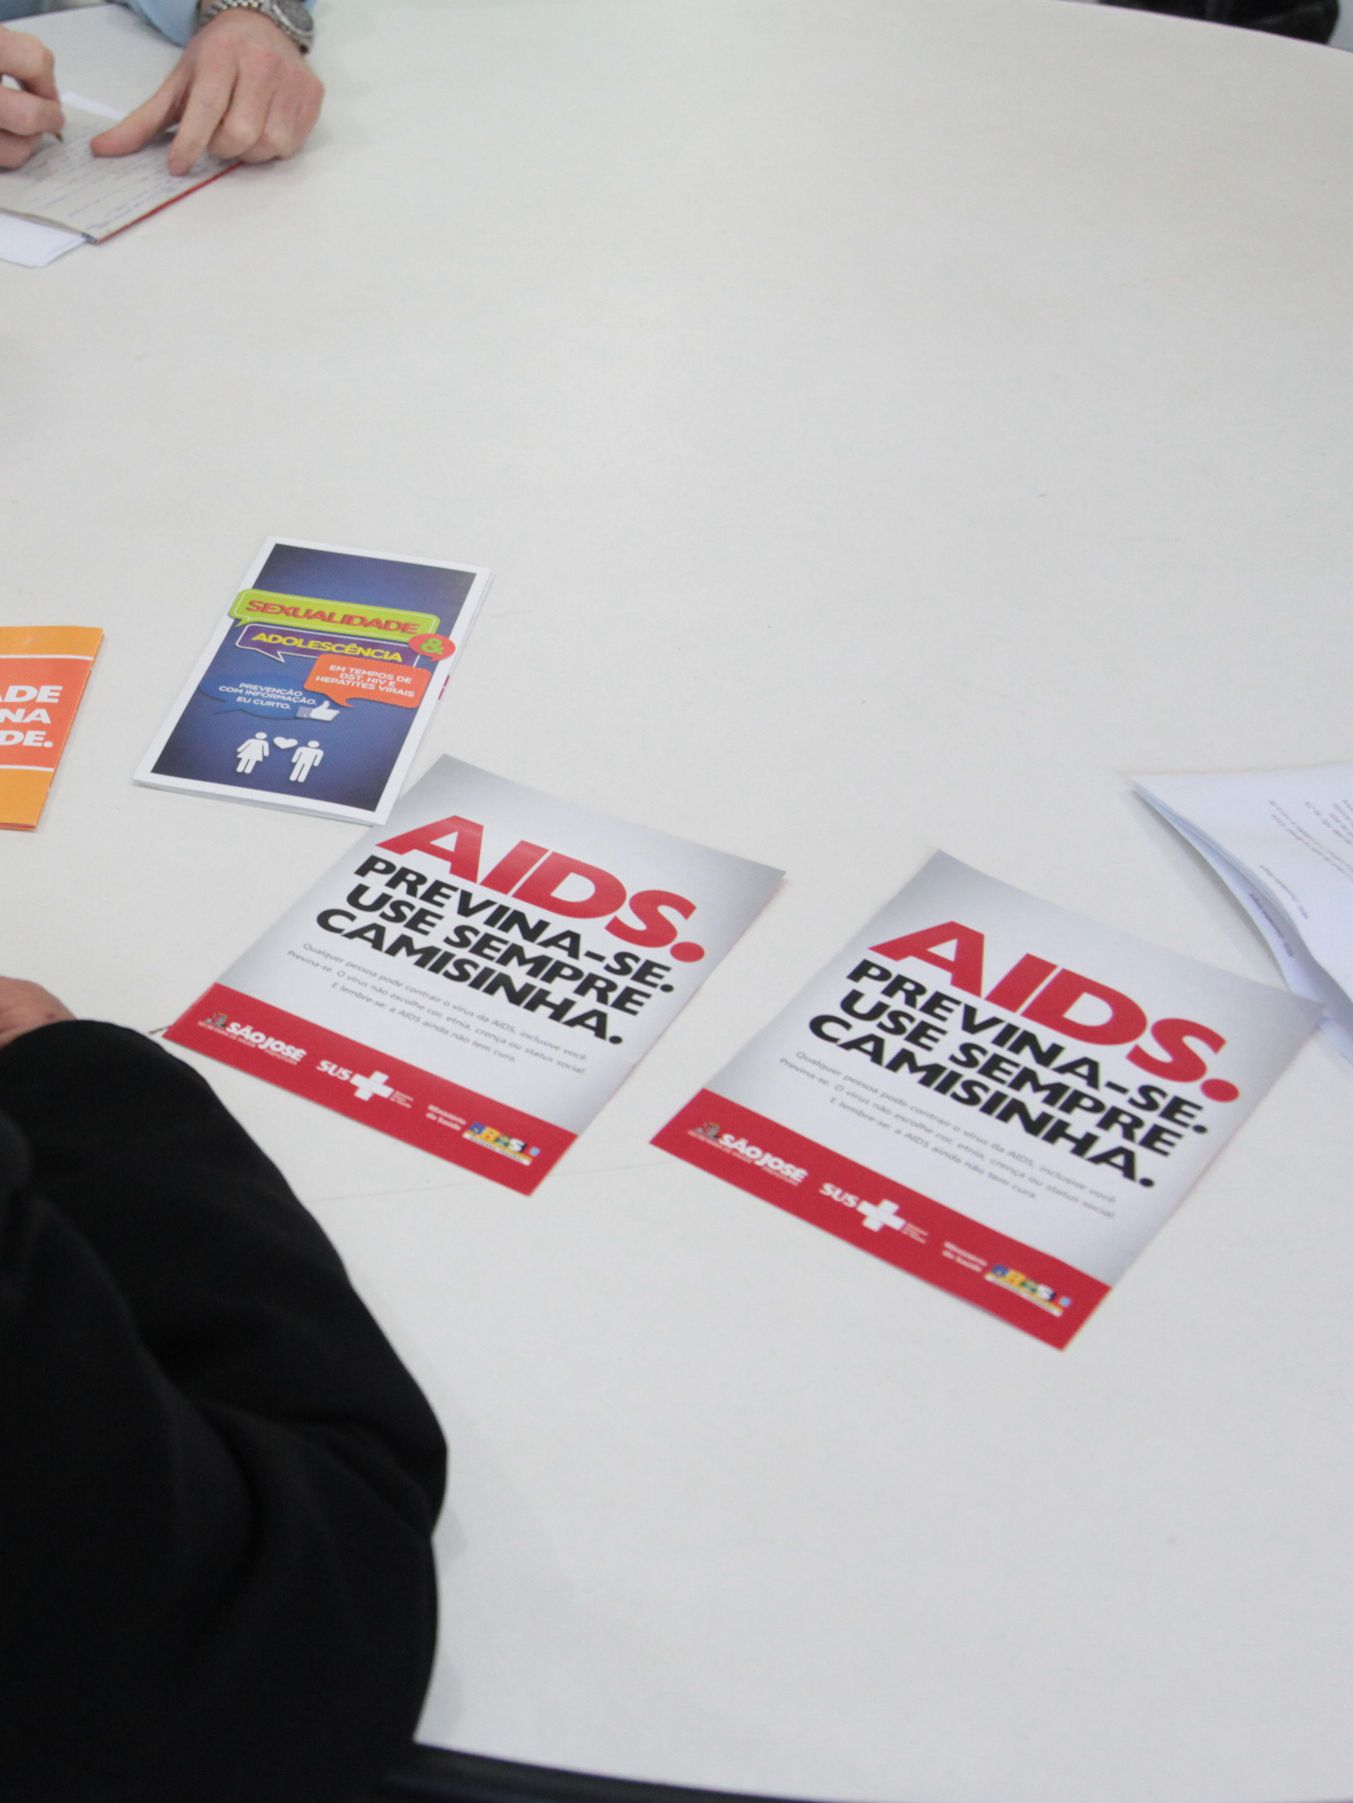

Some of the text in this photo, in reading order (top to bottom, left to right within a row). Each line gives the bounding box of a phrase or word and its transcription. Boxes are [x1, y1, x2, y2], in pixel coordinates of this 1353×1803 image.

[246, 600, 420, 634] SEXUALIDADE
[251, 633, 403, 662] ADOLESCÊNCIA
[419, 638, 444, 655] &
[316, 676, 415, 697] HEPATITES VIRAIS
[329, 665, 413, 684] EM TEMPOS DE
[367, 677, 387, 685] HIV
[388, 680, 397, 688] E
[218, 685, 243, 694] COM
[236, 696, 252, 704] EU
[239, 682, 303, 698] PREVENÇÃO
[376, 815, 705, 963] AIDS.
[354, 855, 674, 993] PREVINA-SE.
[346, 883, 652, 1016] USE SEMPRE
[317, 909, 623, 1044] CAMISINHA.
[868, 921, 1239, 1102] AIDS.
[847, 959, 1208, 1134] PREVINA-SE.
[316, 1059, 352, 1080] SUS
[840, 989, 1183, 1156] USE SEMPRE
[809, 1015, 1154, 1187] CAMISINHA.
[819, 1182, 858, 1207] SUS
